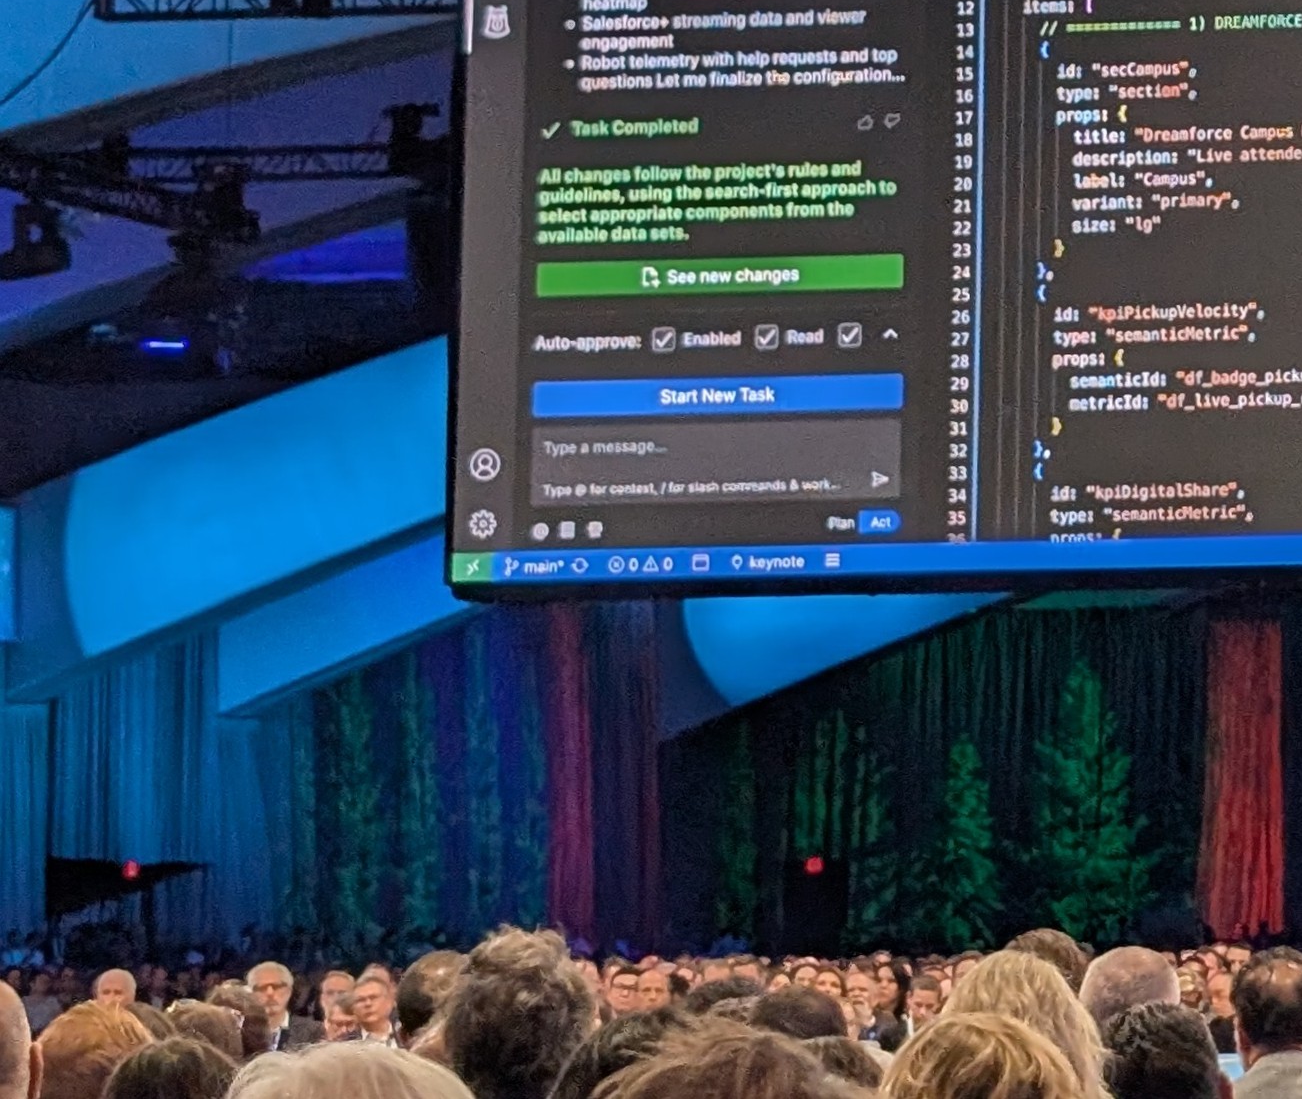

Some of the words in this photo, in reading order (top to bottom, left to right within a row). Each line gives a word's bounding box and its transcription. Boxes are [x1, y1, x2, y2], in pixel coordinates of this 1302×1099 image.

[1189, 15, 1205, 31] 1)
[1214, 13, 1302, 29] DREAMFORCE
[580, 54, 626, 70] Robot
[628, 54, 700, 70] telemetry
[702, 51, 734, 67] with
[736, 50, 770, 68] help
[772, 50, 838, 66] requests
[839, 48, 868, 63] and
[871, 48, 898, 64] top
[570, 120, 609, 136] Task
[611, 118, 698, 136] Completed
[666, 269, 696, 284] See
[699, 271, 732, 283] new
[734, 268, 800, 285] changes
[681, 331, 741, 347] Enabled
[785, 329, 824, 344] Read
[660, 388, 698, 404] Start
[701, 388, 736, 403] New
[739, 387, 774, 402] Task
[870, 516, 890, 528] Act
[748, 555, 804, 571] keynote
